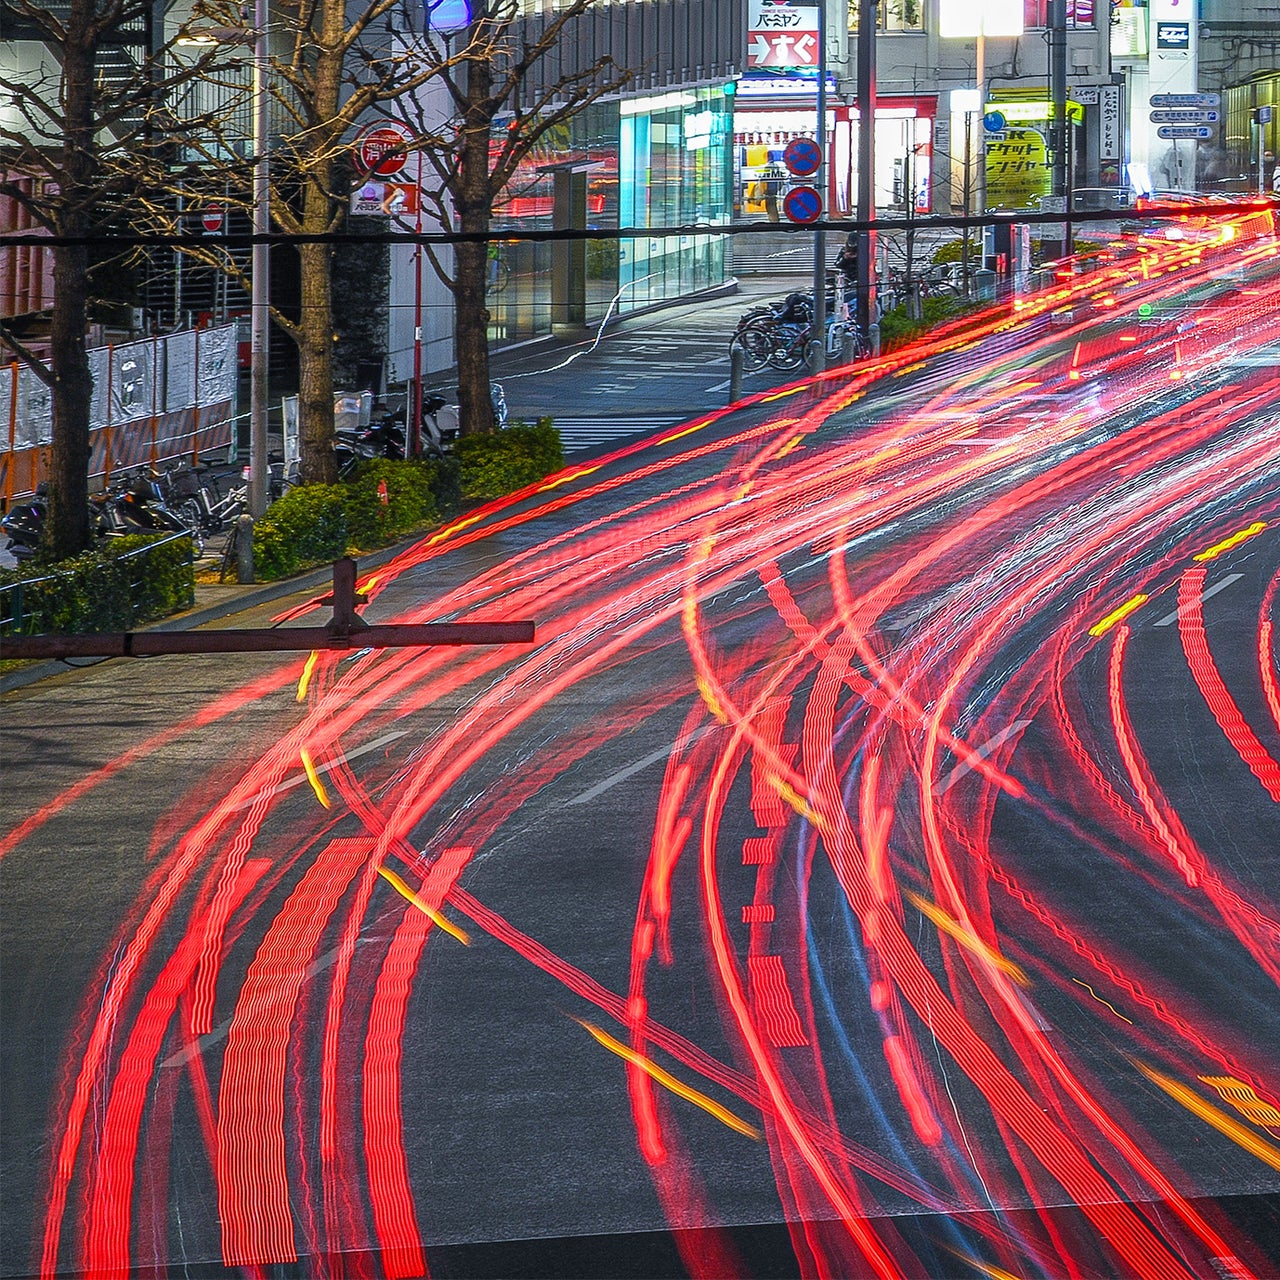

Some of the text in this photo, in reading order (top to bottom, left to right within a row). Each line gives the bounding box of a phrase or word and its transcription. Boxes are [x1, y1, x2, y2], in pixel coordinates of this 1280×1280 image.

[755, 14, 802, 28] バーミヤン
[771, 33, 817, 64] すぐ
